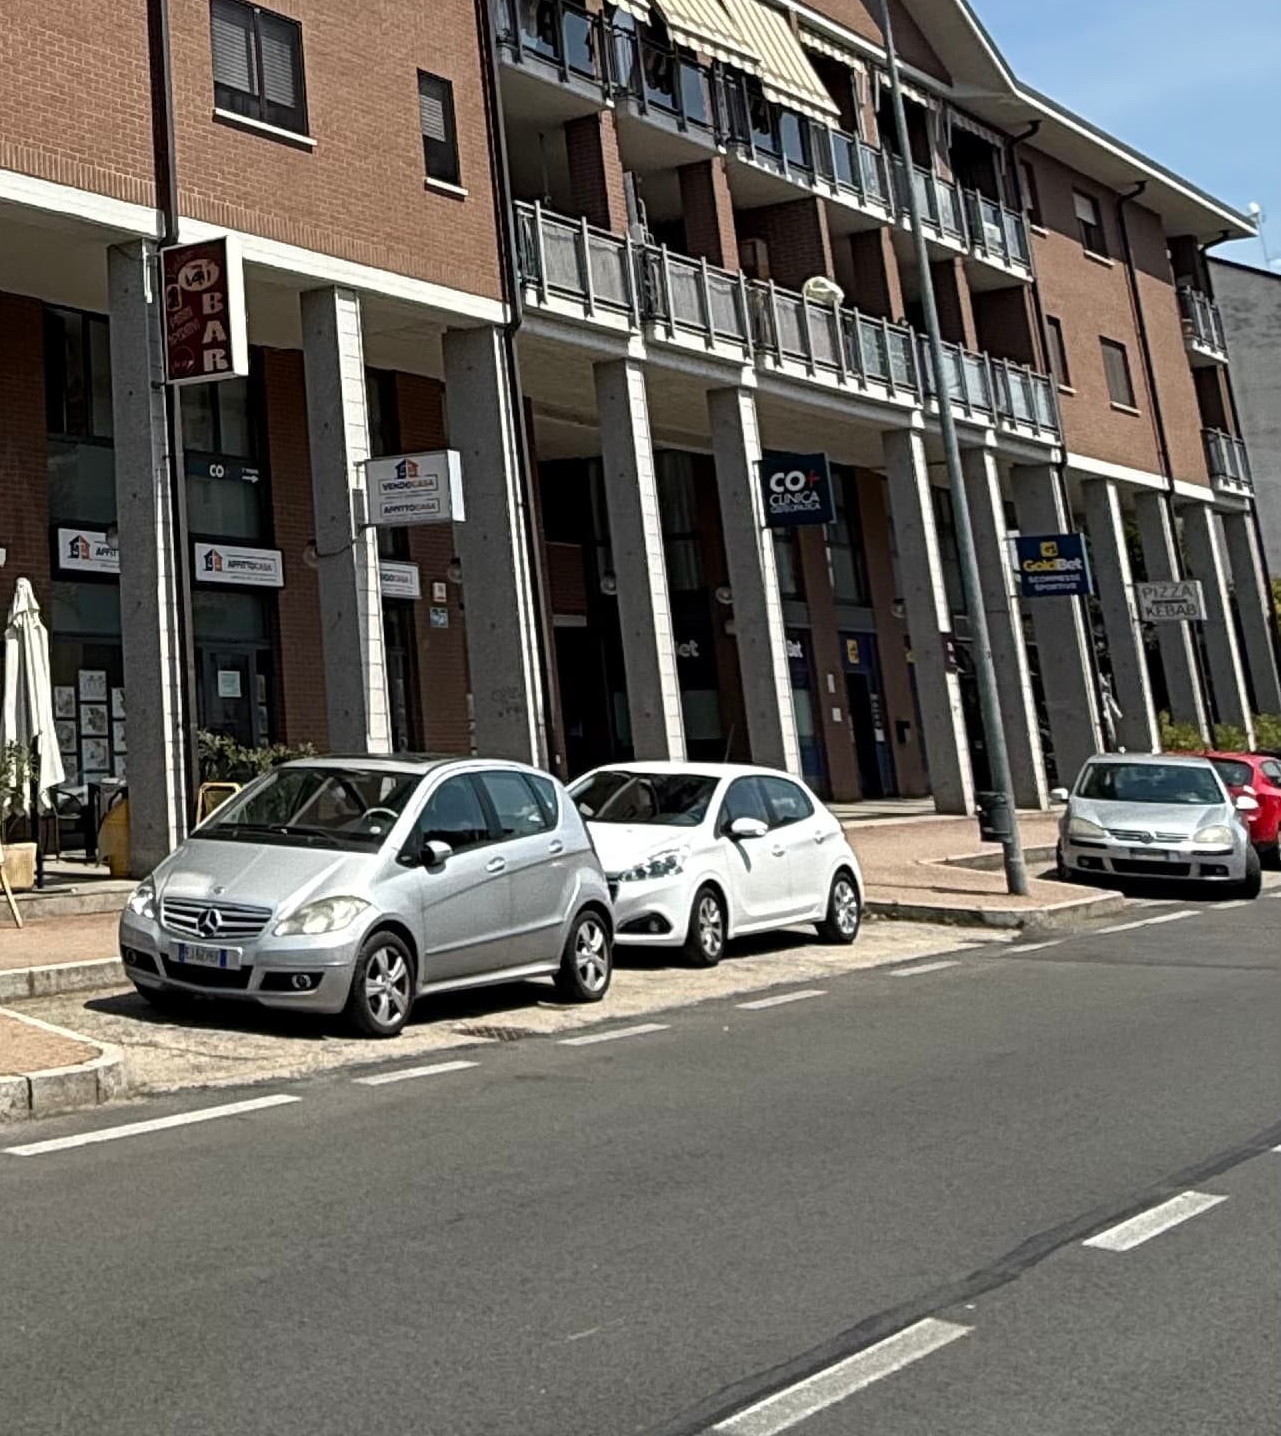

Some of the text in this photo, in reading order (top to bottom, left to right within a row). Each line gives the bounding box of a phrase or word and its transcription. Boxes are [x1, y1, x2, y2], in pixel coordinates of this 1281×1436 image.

[202, 292, 229, 372] BAR
[382, 478, 434, 491] VENDOCASA
[769, 490, 820, 507] CLINICA
[1023, 557, 1083, 573] GoldBet
[1141, 584, 1193, 600] PIZZA
[1145, 603, 1198, 618] KEBAB
